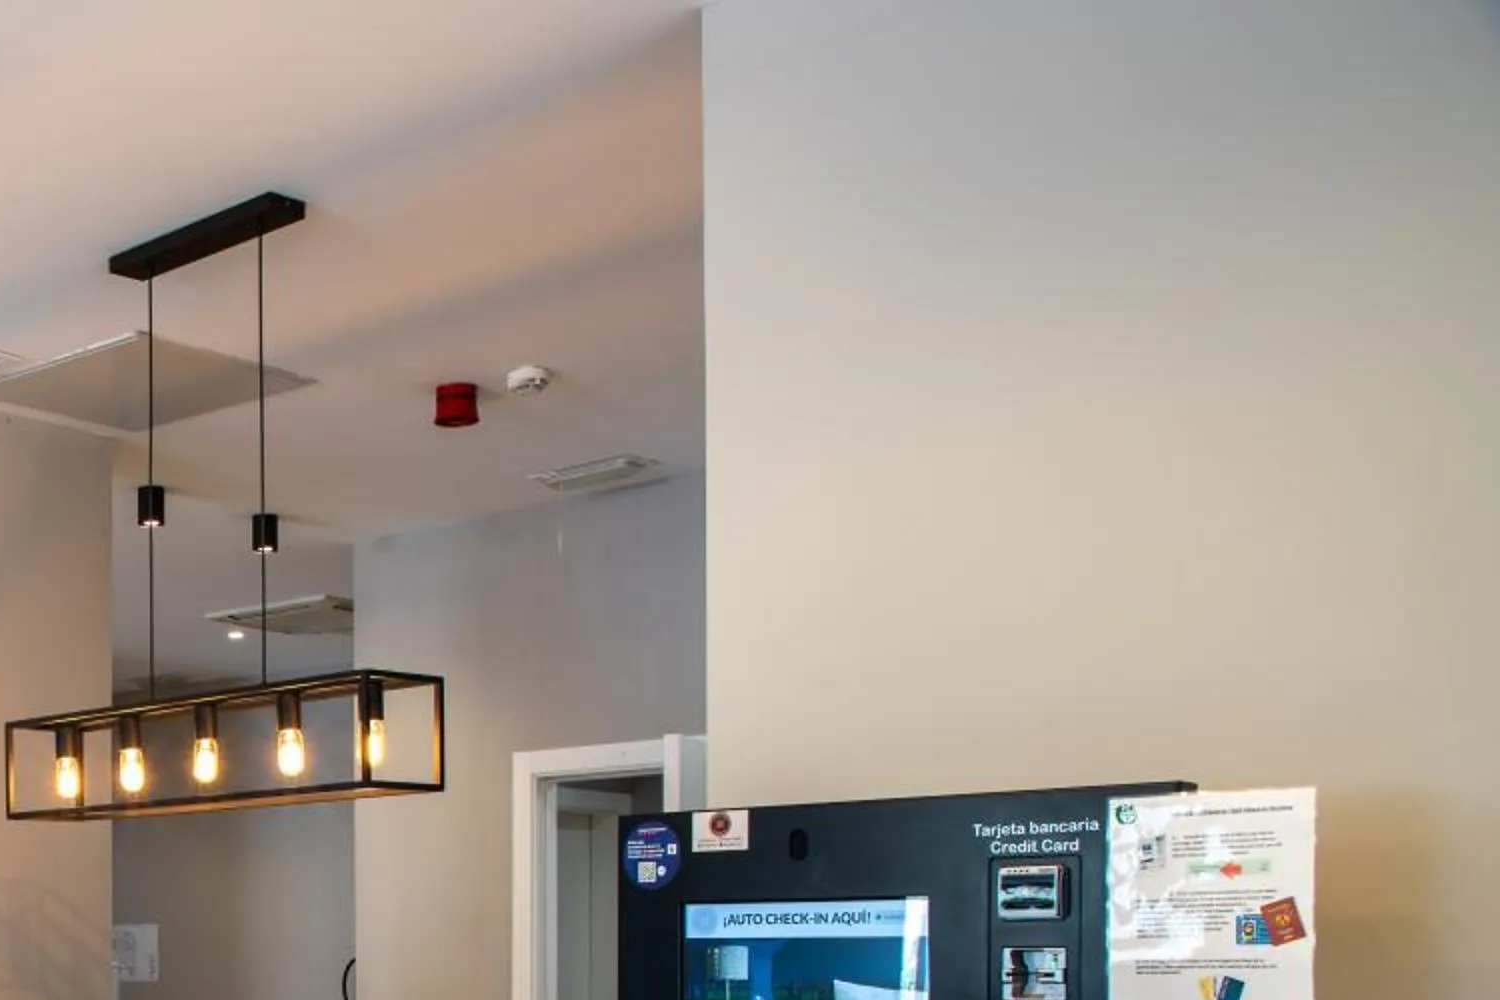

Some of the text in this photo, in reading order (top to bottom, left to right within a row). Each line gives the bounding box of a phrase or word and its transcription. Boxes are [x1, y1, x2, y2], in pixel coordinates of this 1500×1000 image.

[972, 817, 1100, 839] Tarjeta bancaria
[990, 838, 1079, 853] Credit Card
[723, 912, 764, 927] ¡AUTO
[765, 912, 828, 926] CHECK-IN
[831, 909, 871, 926] AQUÍ!
